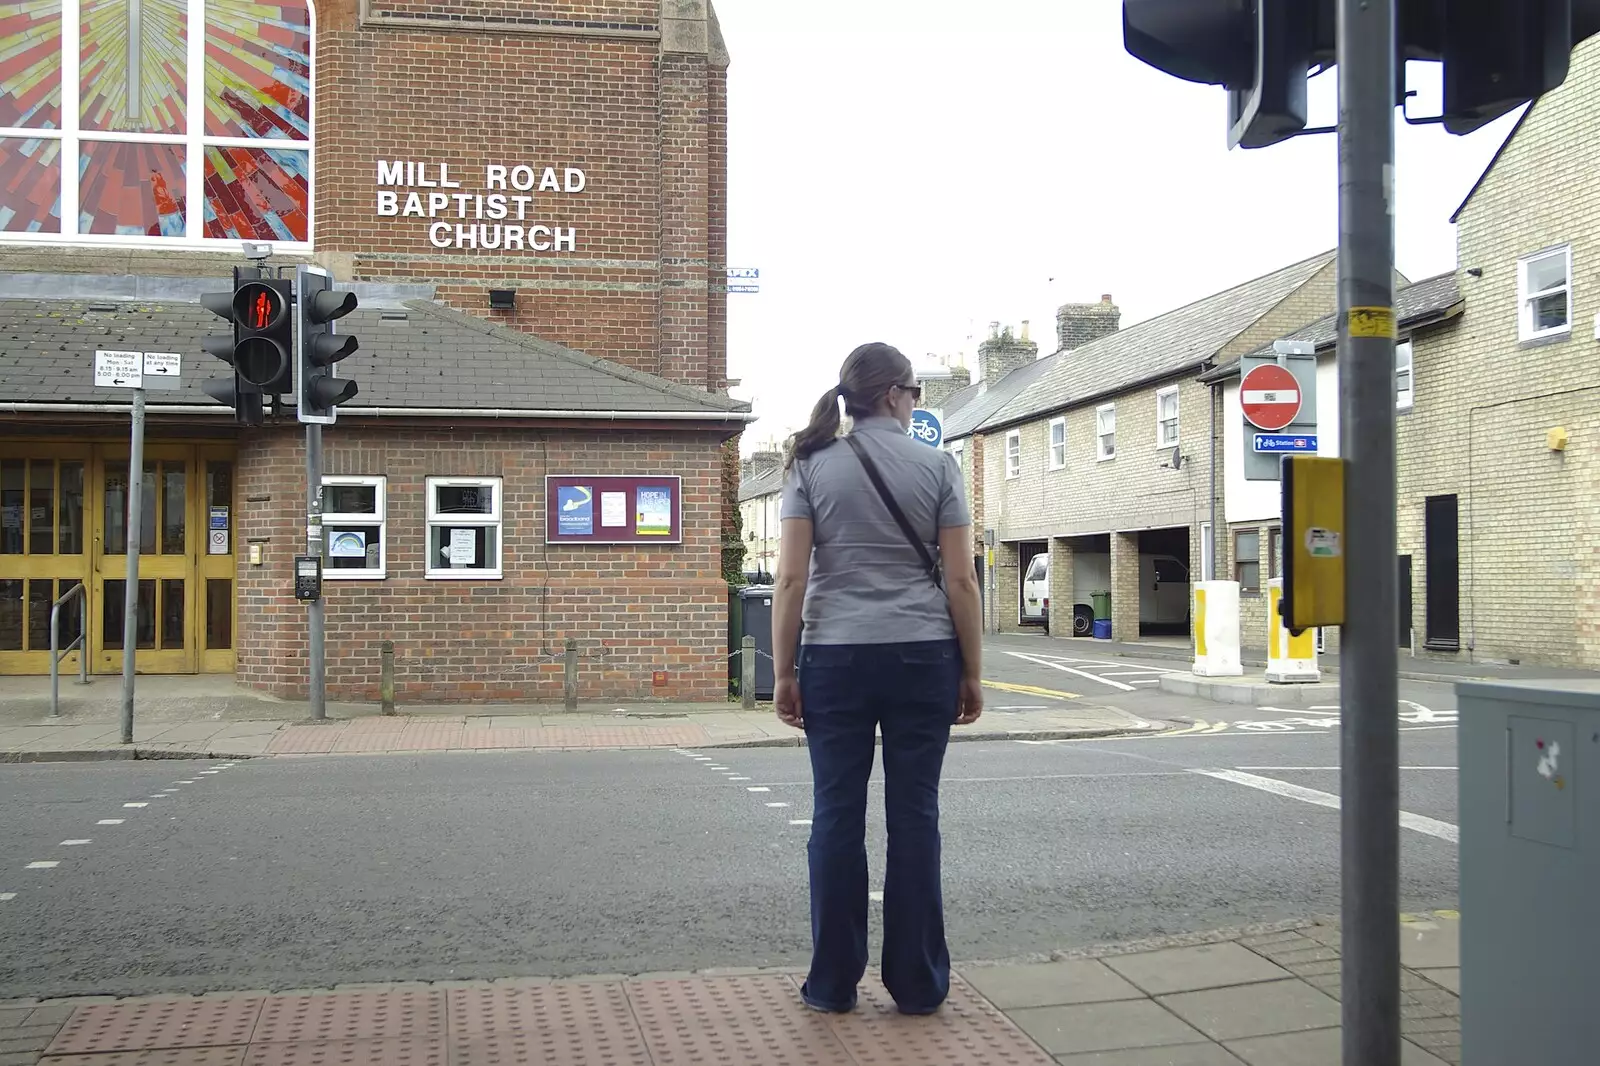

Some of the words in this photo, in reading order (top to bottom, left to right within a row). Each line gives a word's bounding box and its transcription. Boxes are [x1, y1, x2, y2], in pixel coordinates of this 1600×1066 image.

[377, 160, 460, 188] MILL
[486, 164, 586, 193] ROAD
[377, 190, 532, 220] BAPTIST
[429, 221, 576, 252] CHURCH
[640, 491, 658, 499] HOPE
